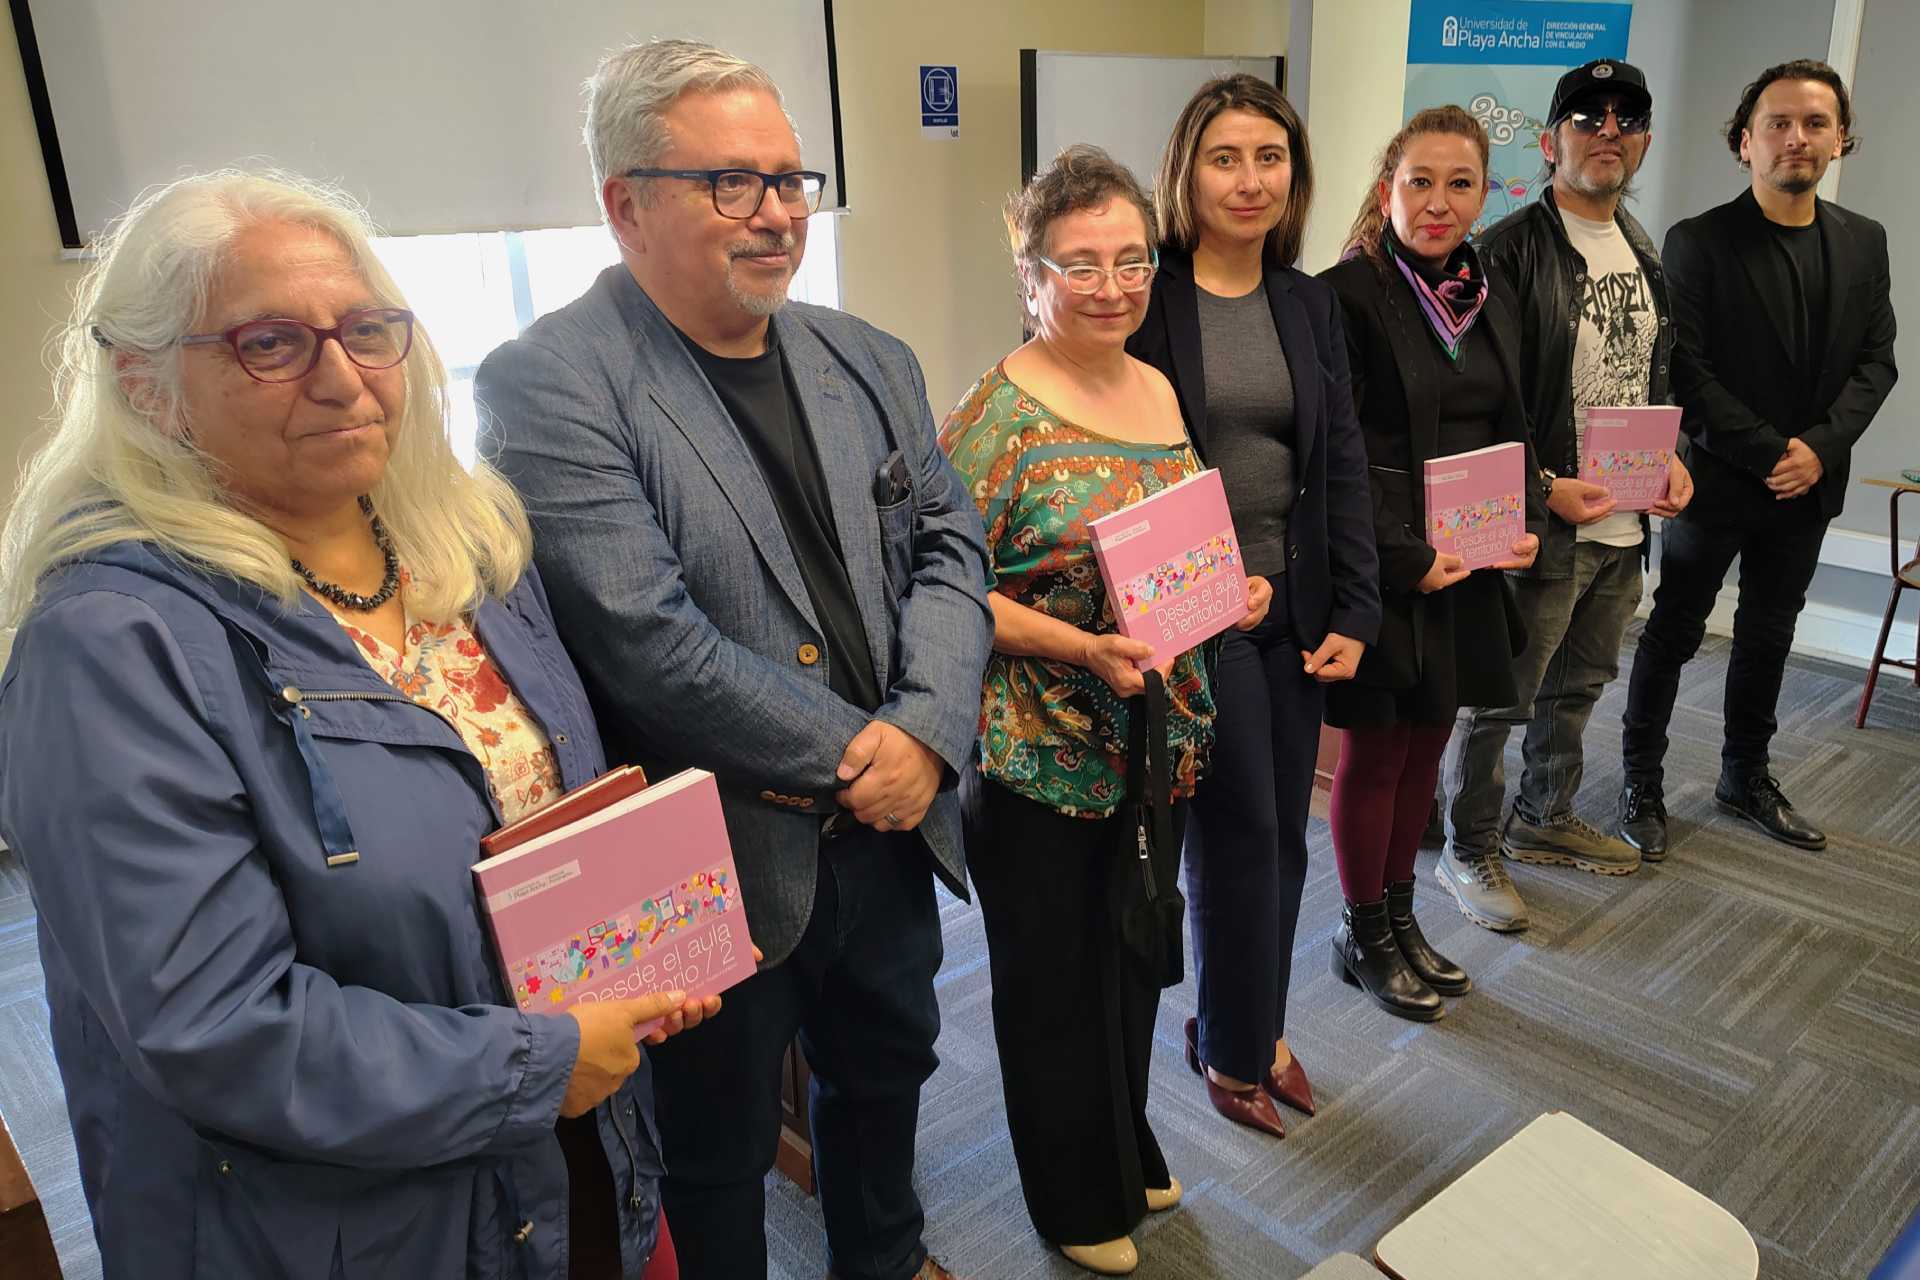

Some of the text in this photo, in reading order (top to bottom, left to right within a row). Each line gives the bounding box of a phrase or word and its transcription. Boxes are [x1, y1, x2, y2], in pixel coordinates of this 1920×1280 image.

[1459, 16, 1528, 31] Universidad de
[1545, 31, 1554, 39] DE
[1579, 22, 1606, 31] GENERAL
[1458, 29, 1540, 52] Playa Ancha
[1545, 40, 1558, 48] CON
[1567, 40, 1586, 49] MEDIO
[1155, 595, 1199, 626] Desde
[1201, 584, 1214, 602] el
[1215, 573, 1239, 596] aula
[1162, 623, 1176, 641] al
[1175, 599, 1224, 634] territorio
[1232, 585, 1242, 602] 2
[578, 964, 656, 1003] Desde
[662, 943, 682, 972] el
[687, 922, 732, 959] aula
[720, 940, 736, 966] 2
